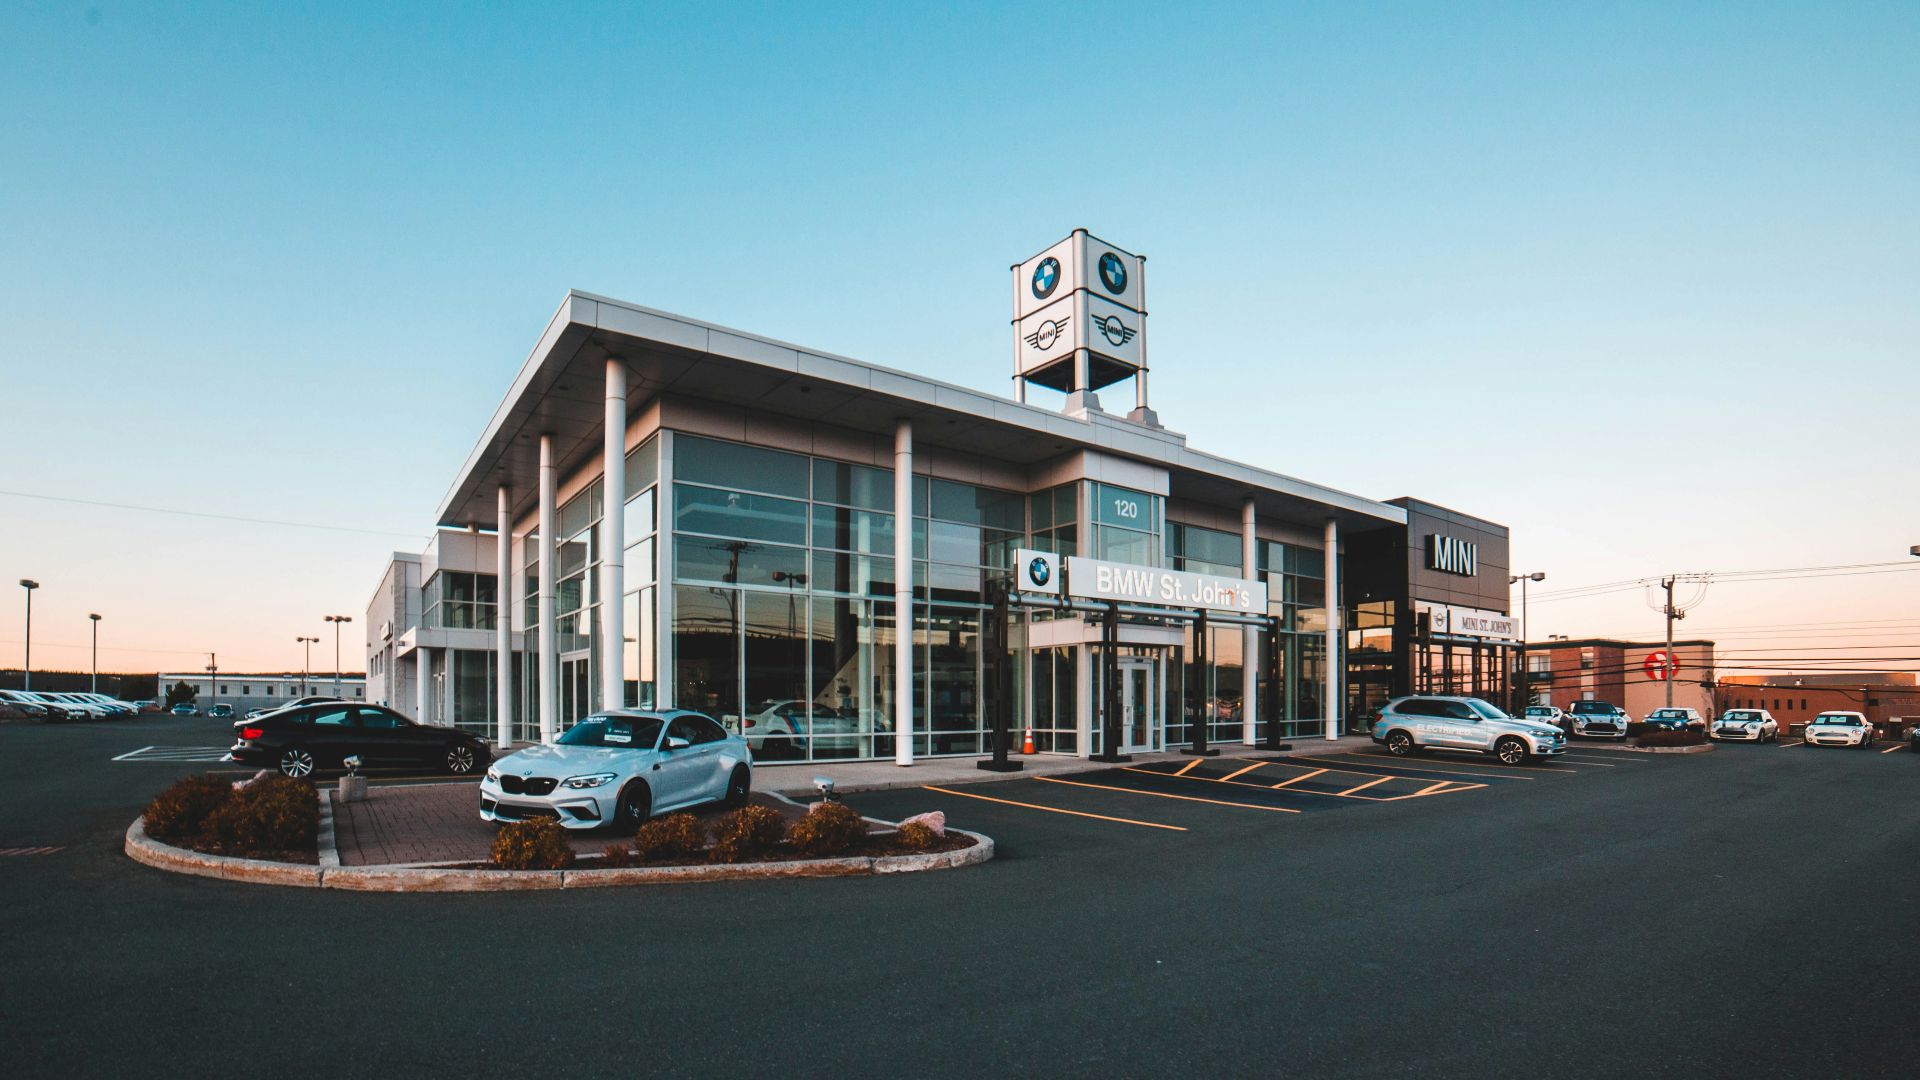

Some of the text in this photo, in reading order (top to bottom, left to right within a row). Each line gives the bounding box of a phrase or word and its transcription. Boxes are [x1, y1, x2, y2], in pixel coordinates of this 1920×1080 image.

[1039, 328, 1055, 341] MINI
[1107, 324, 1122, 337] MINI
[1114, 499, 1137, 518] 120
[1433, 533, 1477, 577] MINI
[1096, 565, 1250, 608] BMW St. John's
[1462, 616, 1512, 634] MINI ST. JOHN'S
